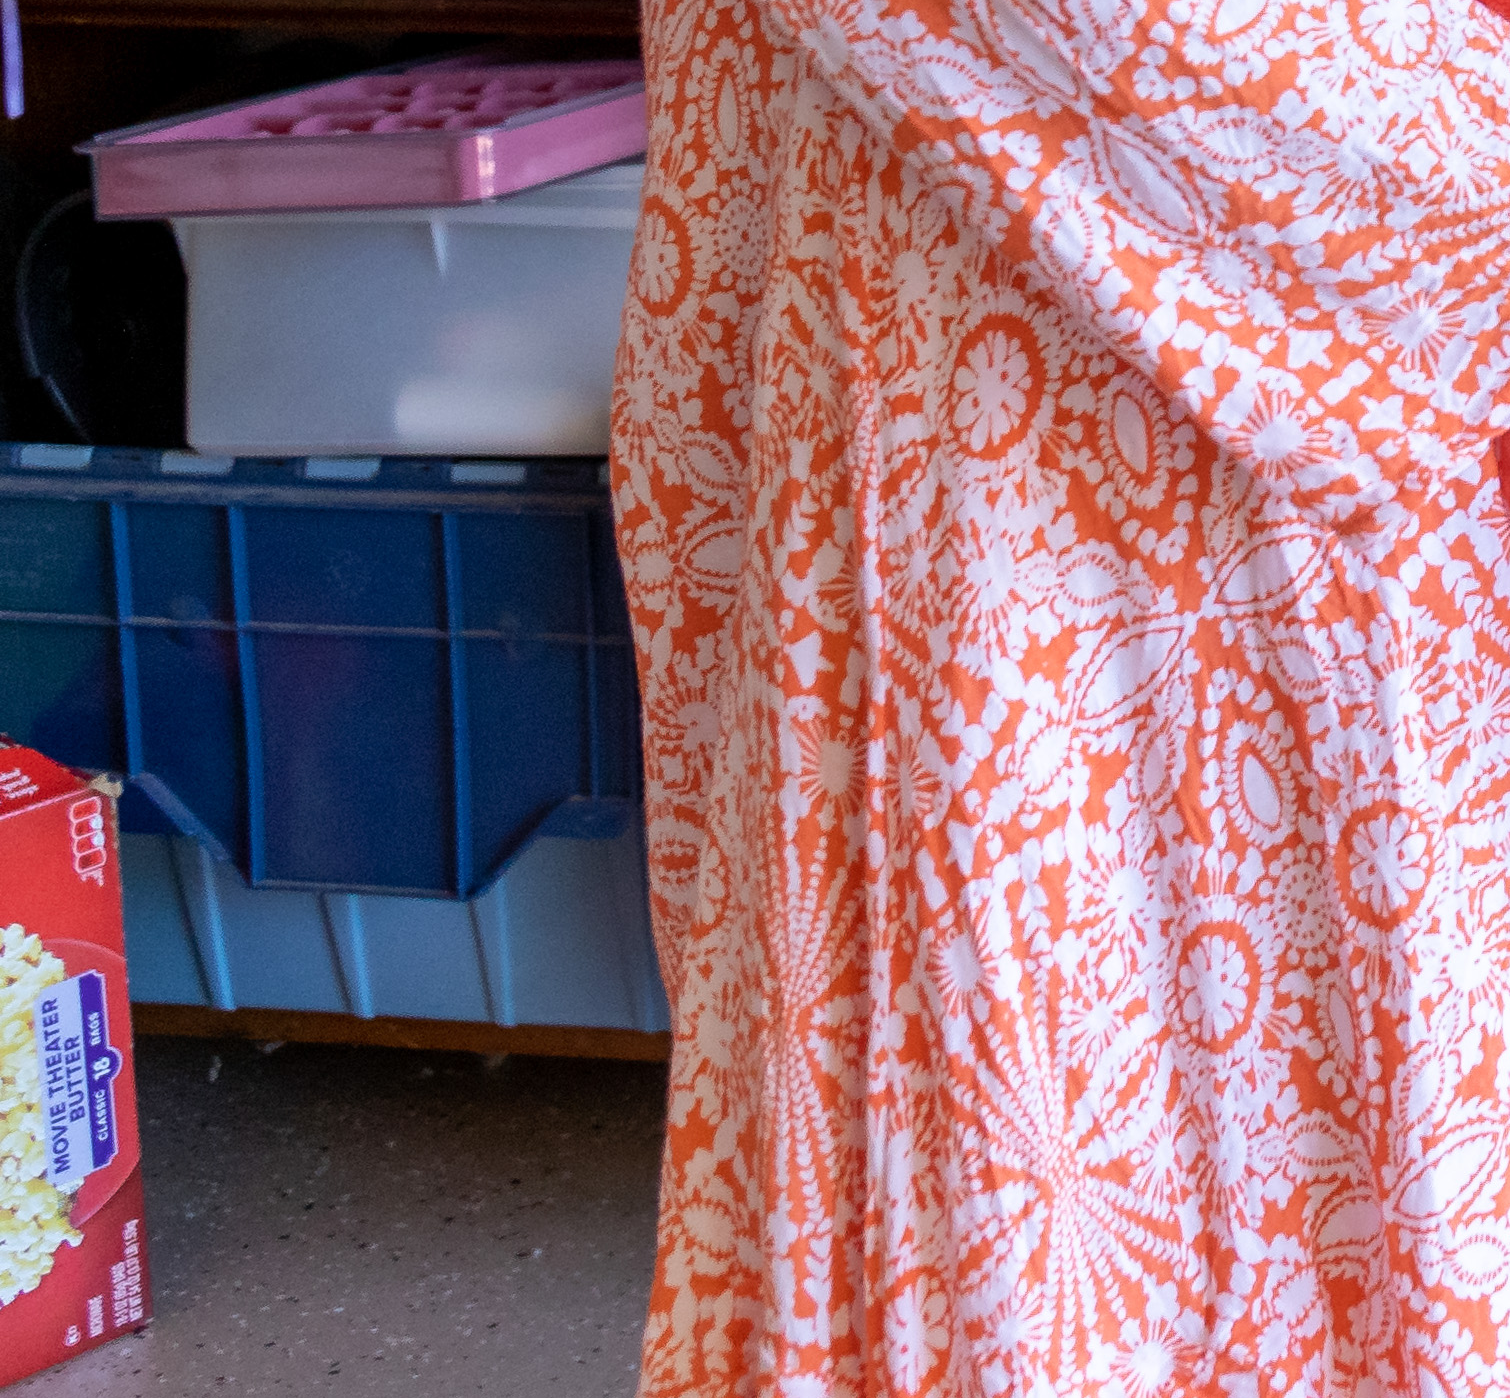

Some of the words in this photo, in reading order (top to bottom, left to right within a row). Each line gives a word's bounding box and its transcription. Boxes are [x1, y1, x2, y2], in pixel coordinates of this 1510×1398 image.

[41, 997, 65, 1100] THEATER
[64, 1035, 86, 1124] BUTTER
[50, 1104, 71, 1174] MOVIE
